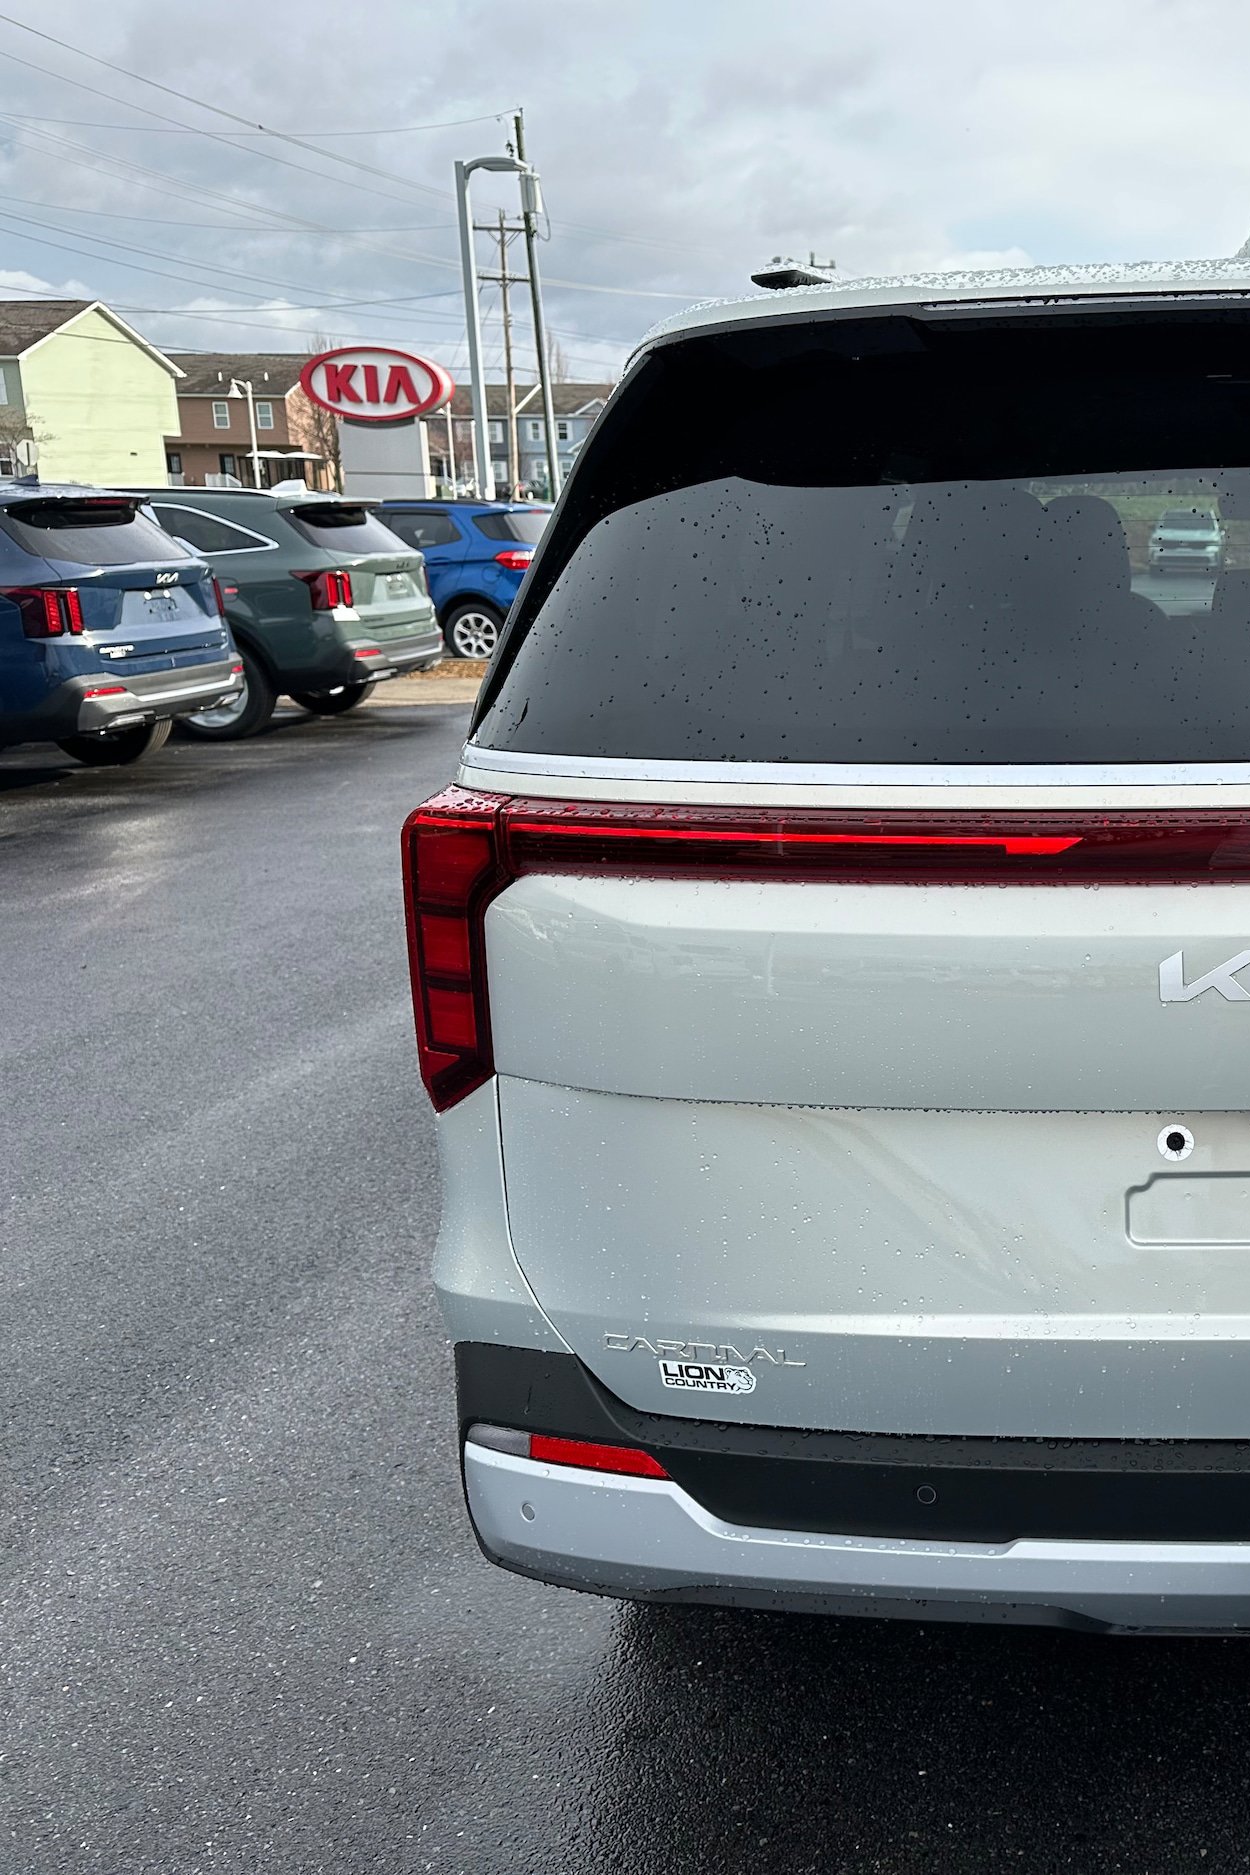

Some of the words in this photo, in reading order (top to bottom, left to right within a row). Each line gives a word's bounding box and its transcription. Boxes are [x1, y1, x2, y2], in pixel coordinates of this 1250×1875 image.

[322, 364, 421, 405] KIA
[663, 1362, 725, 1381] LION
[664, 1377, 737, 1391] COUNTRY
